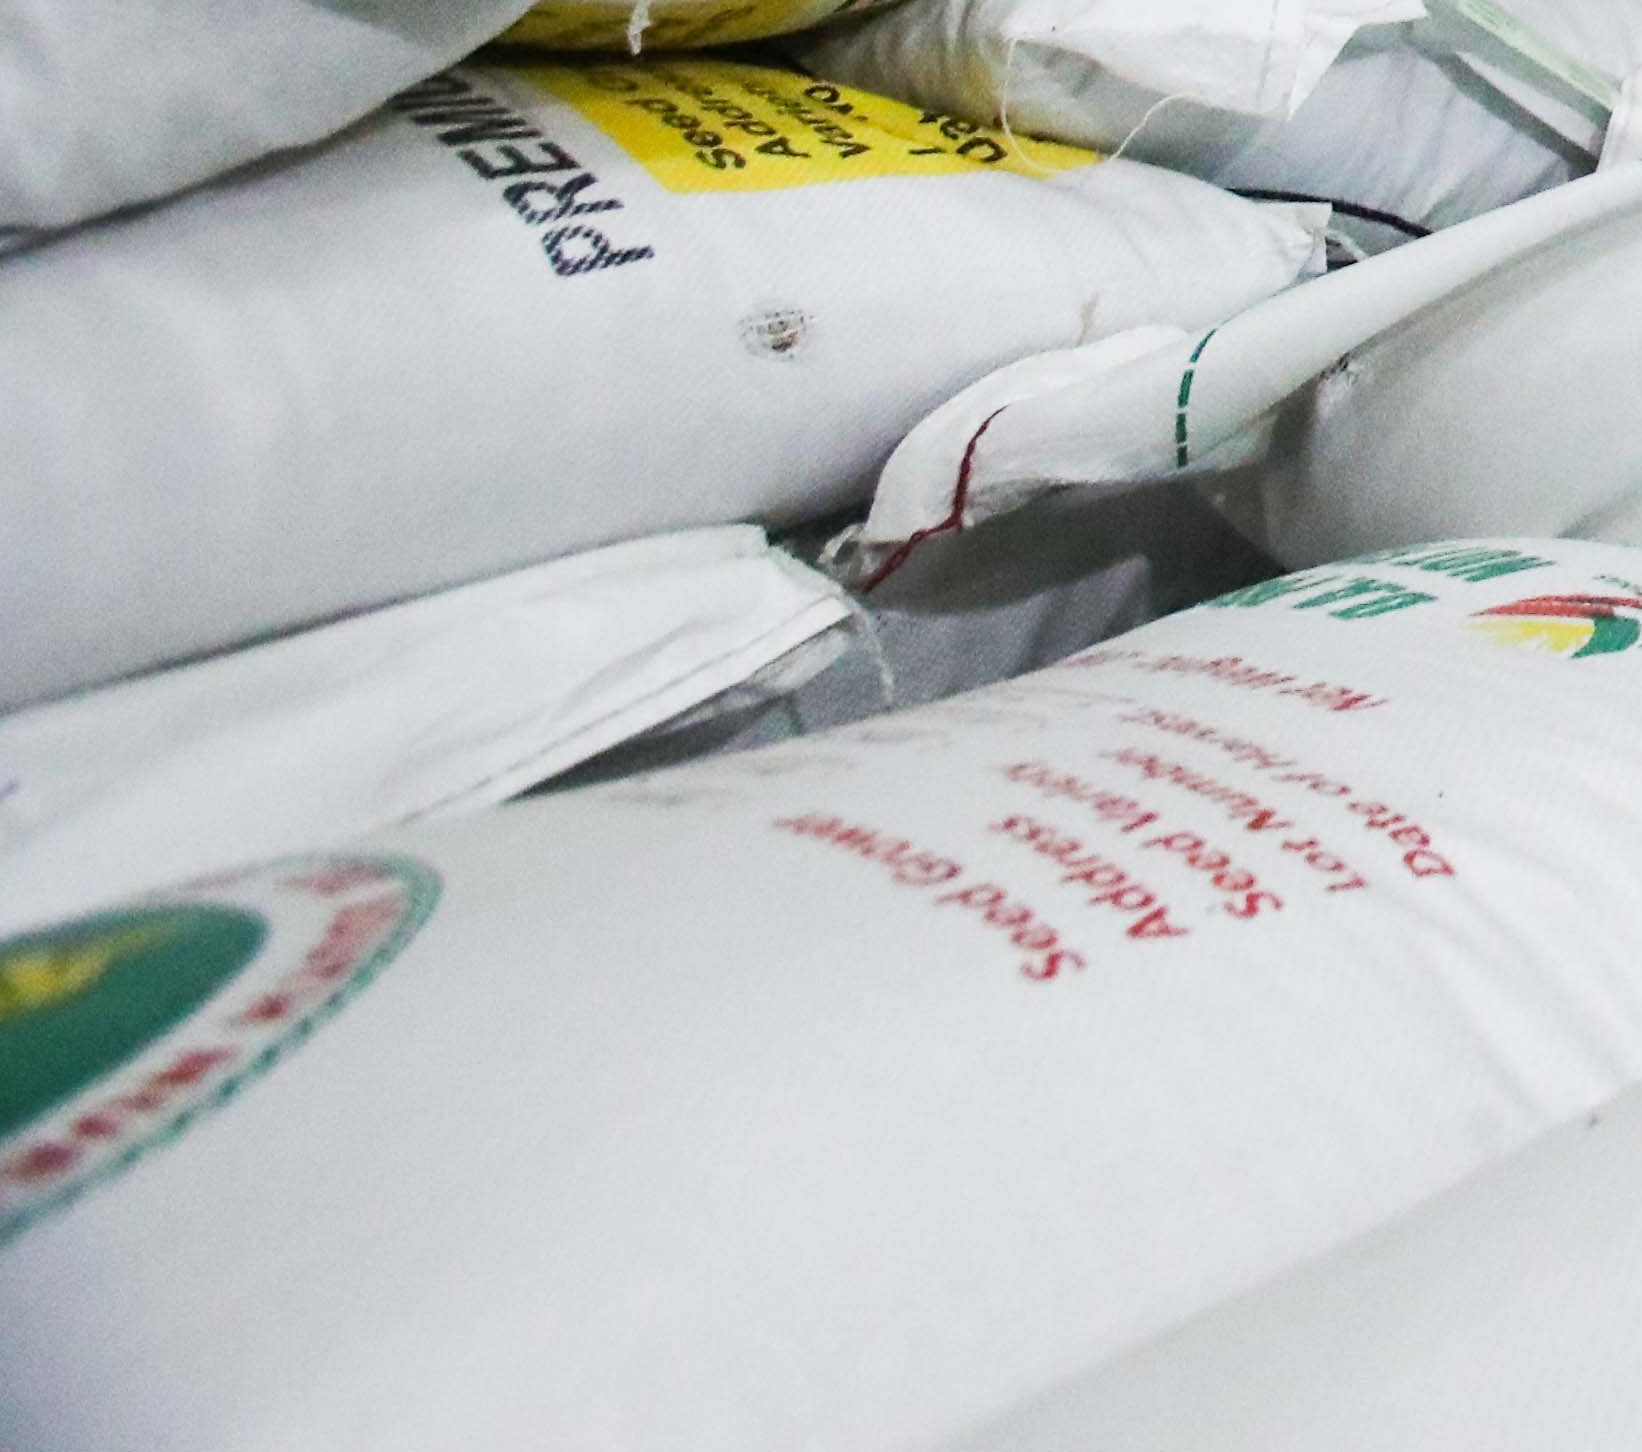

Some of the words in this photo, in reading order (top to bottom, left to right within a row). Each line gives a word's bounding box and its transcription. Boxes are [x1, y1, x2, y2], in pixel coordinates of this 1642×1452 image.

[986, 812, 1193, 939] Address
[1142, 830, 1284, 920] Seed
[1346, 799, 1458, 878] Date
[933, 882, 1087, 983] Seed
